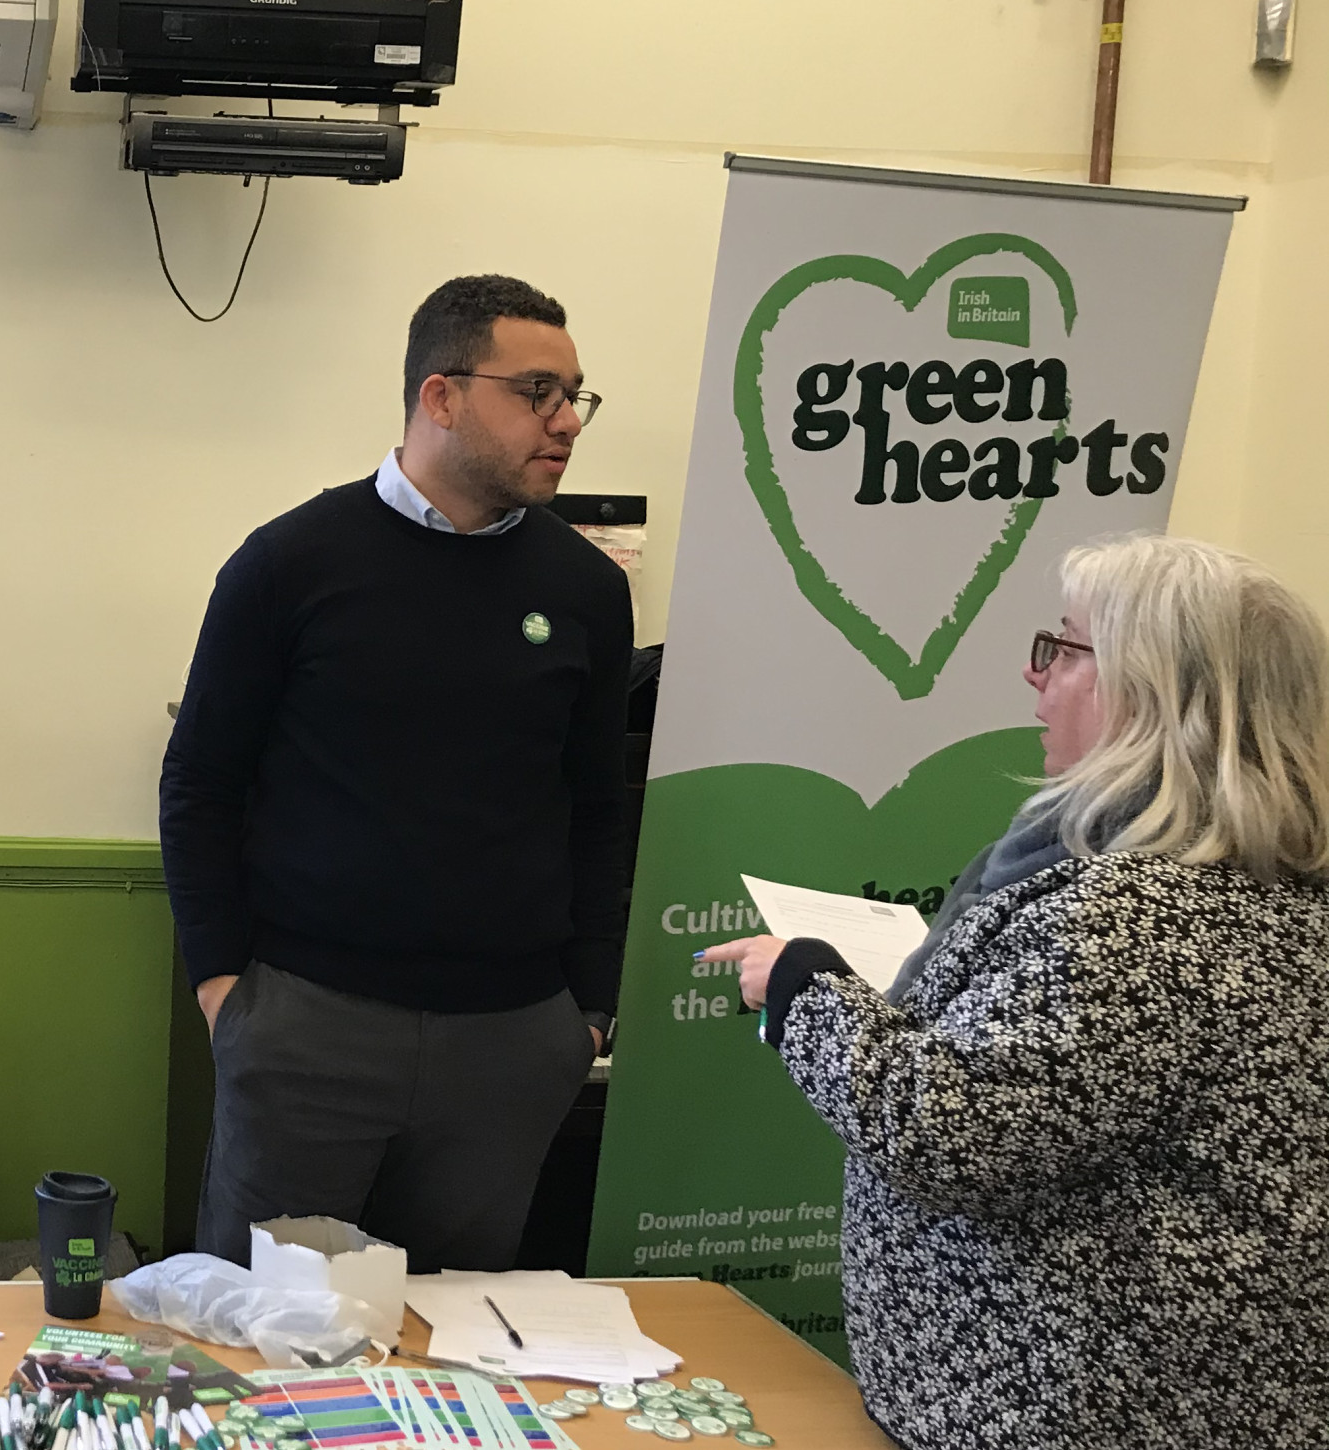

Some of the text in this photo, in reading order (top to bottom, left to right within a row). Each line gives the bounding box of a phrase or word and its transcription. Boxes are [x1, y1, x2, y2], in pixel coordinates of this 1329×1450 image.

[957, 289, 990, 306] Irish
[957, 306, 1021, 323] in Britain
[791, 357, 1070, 452] green
[853, 418, 1170, 505] hearts
[671, 988, 730, 1021] the
[637, 1201, 838, 1231] Download your free
[633, 1239, 695, 1266] guide
[697, 1236, 746, 1257] from
[751, 1232, 784, 1252] the
[41, 1333, 69, 1344] YOUR
[70, 1337, 136, 1352] COMMUNITY
[45, 1327, 127, 1343] VOLUNTEER FOR
